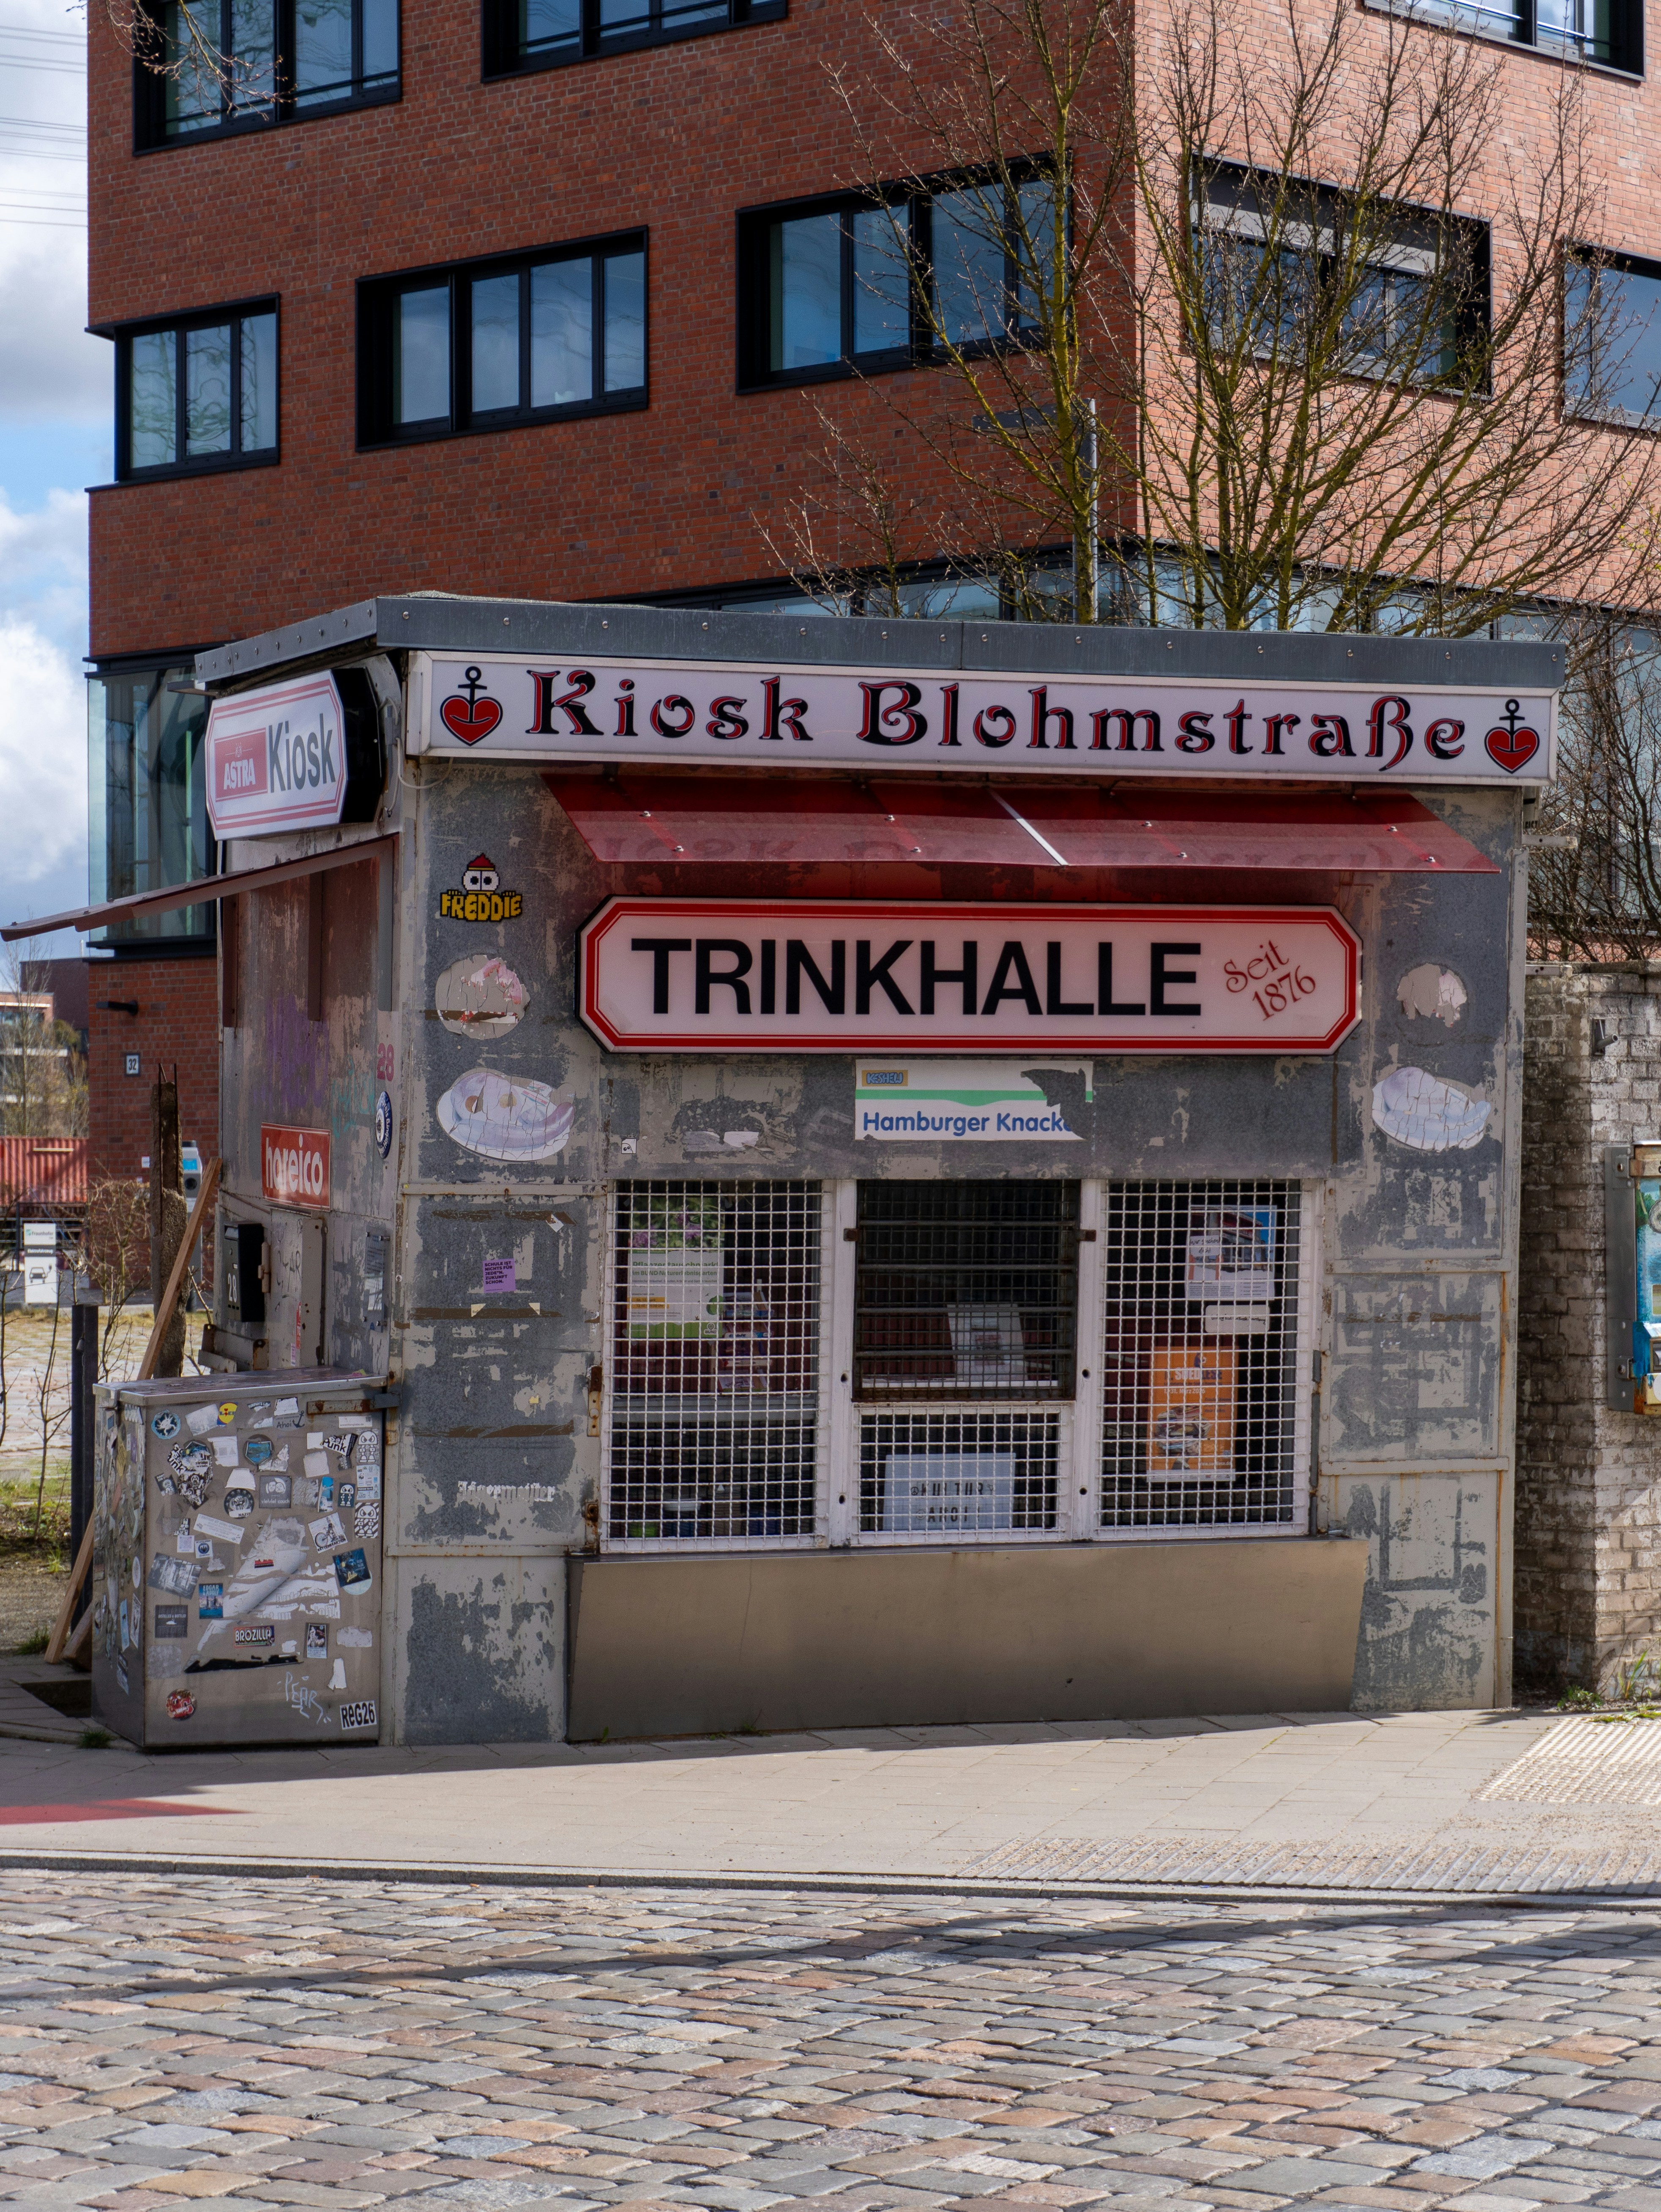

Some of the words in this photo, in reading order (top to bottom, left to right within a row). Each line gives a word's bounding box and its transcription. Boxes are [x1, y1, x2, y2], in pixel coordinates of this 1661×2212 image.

[525, 669, 814, 742] Kiosk
[855, 681, 1466, 772] Blohmstraße
[268, 713, 336, 794] Kiosk
[223, 758, 256, 790] ASTRA
[440, 892, 523, 922] FREDDIE
[631, 938, 1202, 1017] TRINKHALLE
[1224, 940, 1289, 993] Seit
[1252, 965, 1316, 1021] 1876
[128, 1058, 137, 1071] 32
[377, 1042, 394, 1082] 28
[866, 1072, 904, 1084] KESHEW
[863, 1110, 990, 1137] Hamburger
[266, 1133, 323, 1196] hareico
[227, 1273, 238, 1303] 28
[276, 1420, 292, 1429] Ahoi
[322, 1438, 347, 1453] Punk
[921, 1482, 984, 1496] KULTUR
[235, 1627, 272, 1642] BROZILLA
